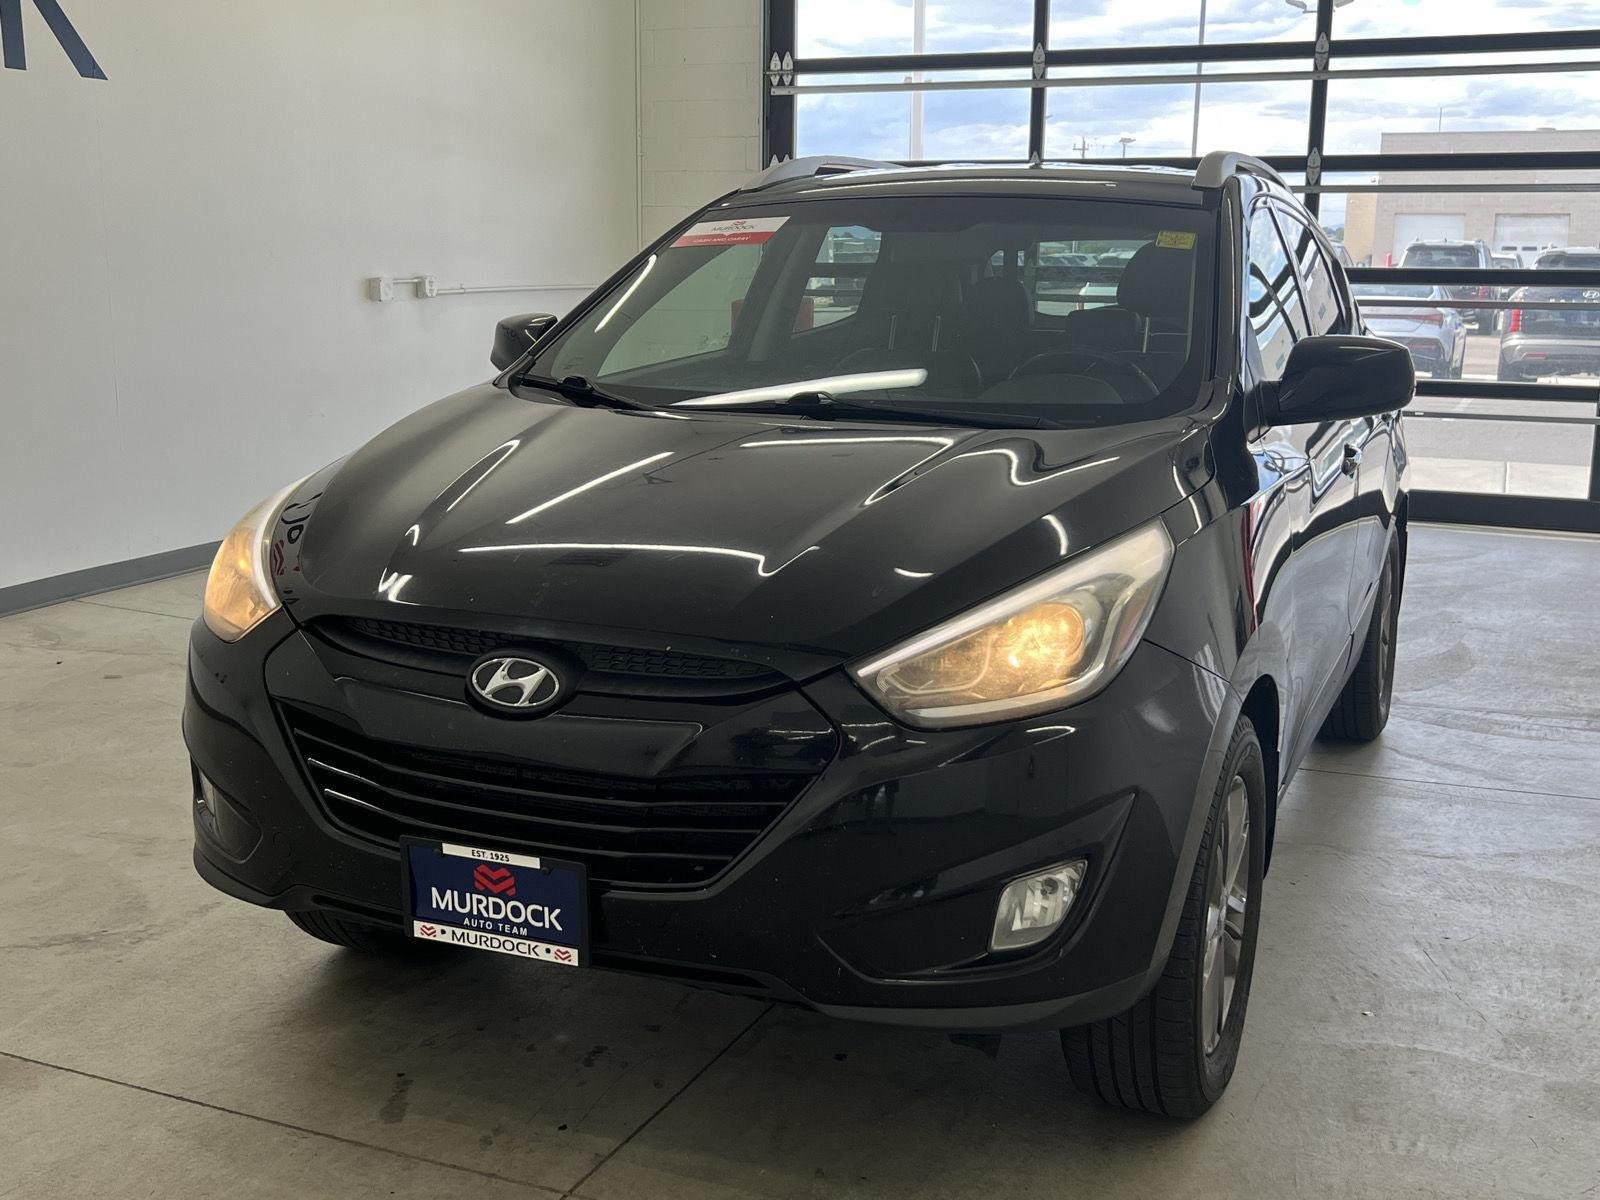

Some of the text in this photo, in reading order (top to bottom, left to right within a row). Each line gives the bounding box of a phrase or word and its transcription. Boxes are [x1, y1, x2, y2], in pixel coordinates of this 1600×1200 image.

[471, 849, 510, 862] EST. 1925
[431, 886, 563, 931] MURDOCK
[463, 917, 528, 936] AUTO TEAM
[451, 929, 540, 957] MURDOCK
